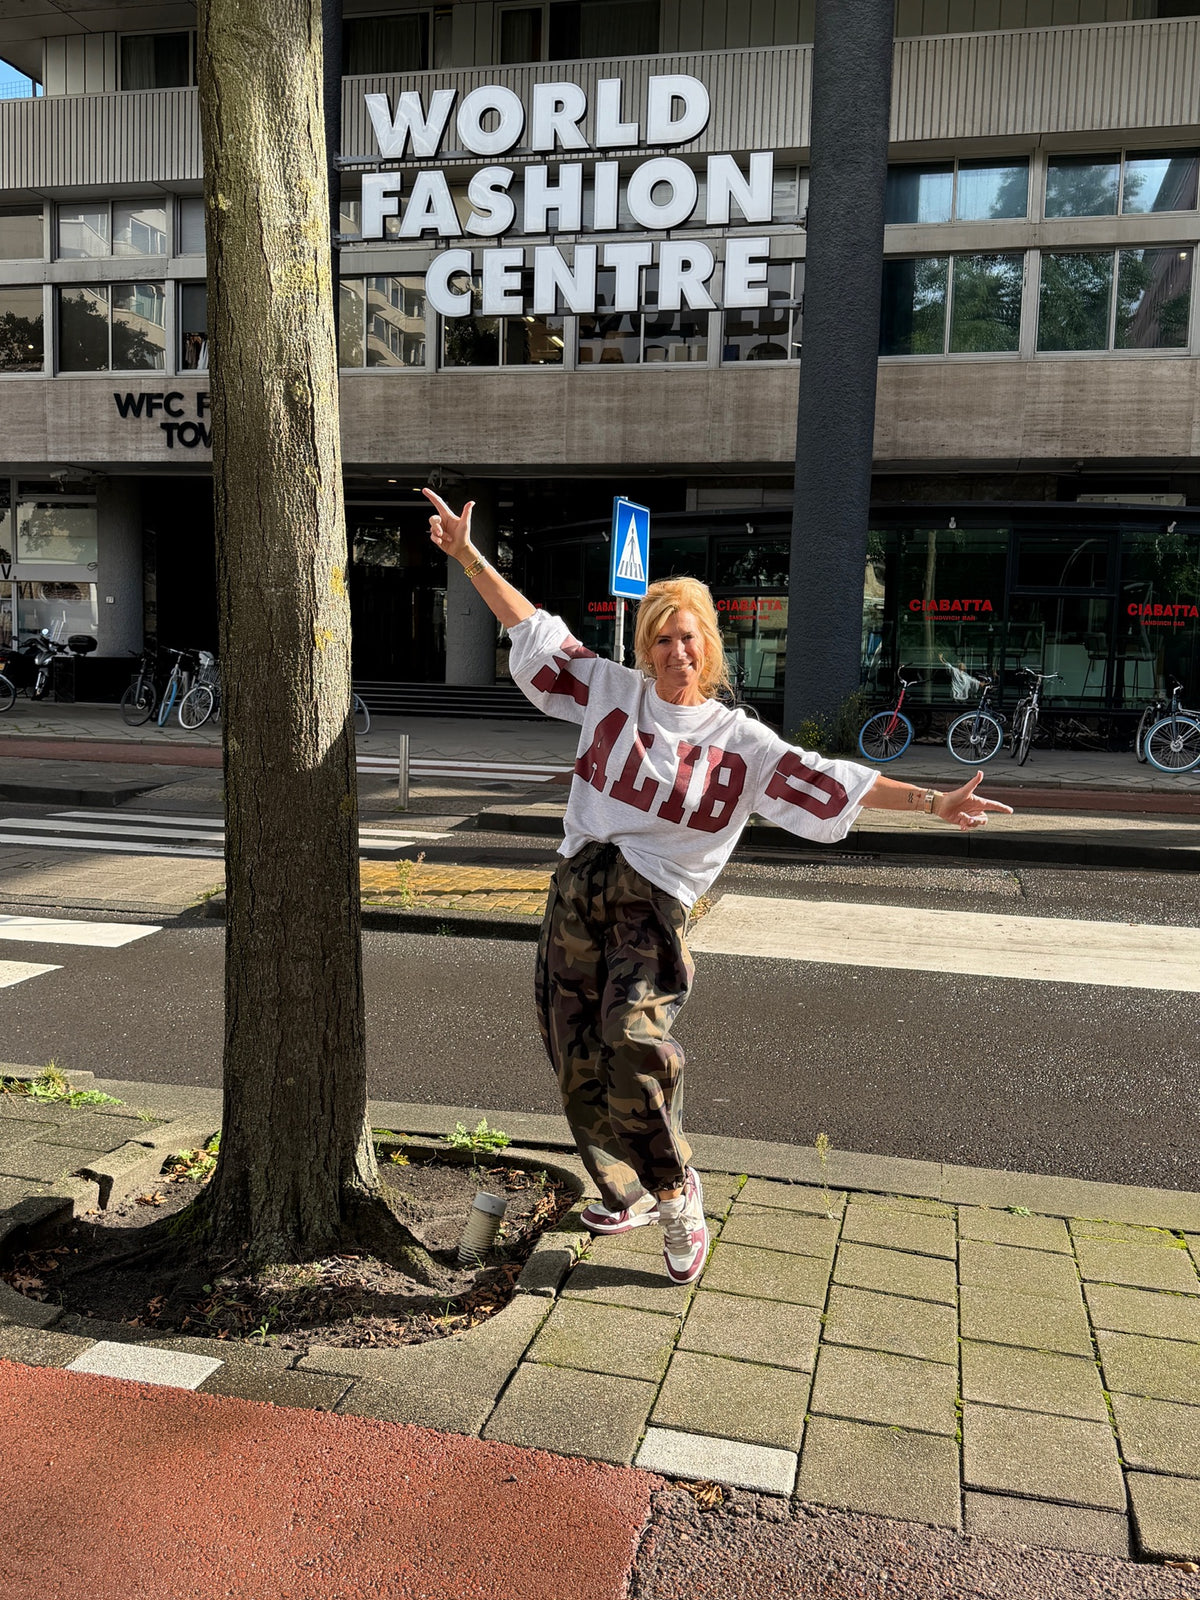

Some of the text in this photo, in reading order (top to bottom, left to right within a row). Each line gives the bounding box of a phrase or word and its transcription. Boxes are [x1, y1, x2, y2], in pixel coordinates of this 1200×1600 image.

[364, 74, 710, 160] WORLD
[361, 151, 774, 239] FASHION
[425, 236, 770, 317] CENTRE
[113, 391, 185, 418] WFC
[587, 601, 629, 612] CIABATA
[716, 599, 783, 611] CIABATTA
[909, 599, 993, 612] CIABATTA
[1127, 603, 1199, 617] CIABATTA
